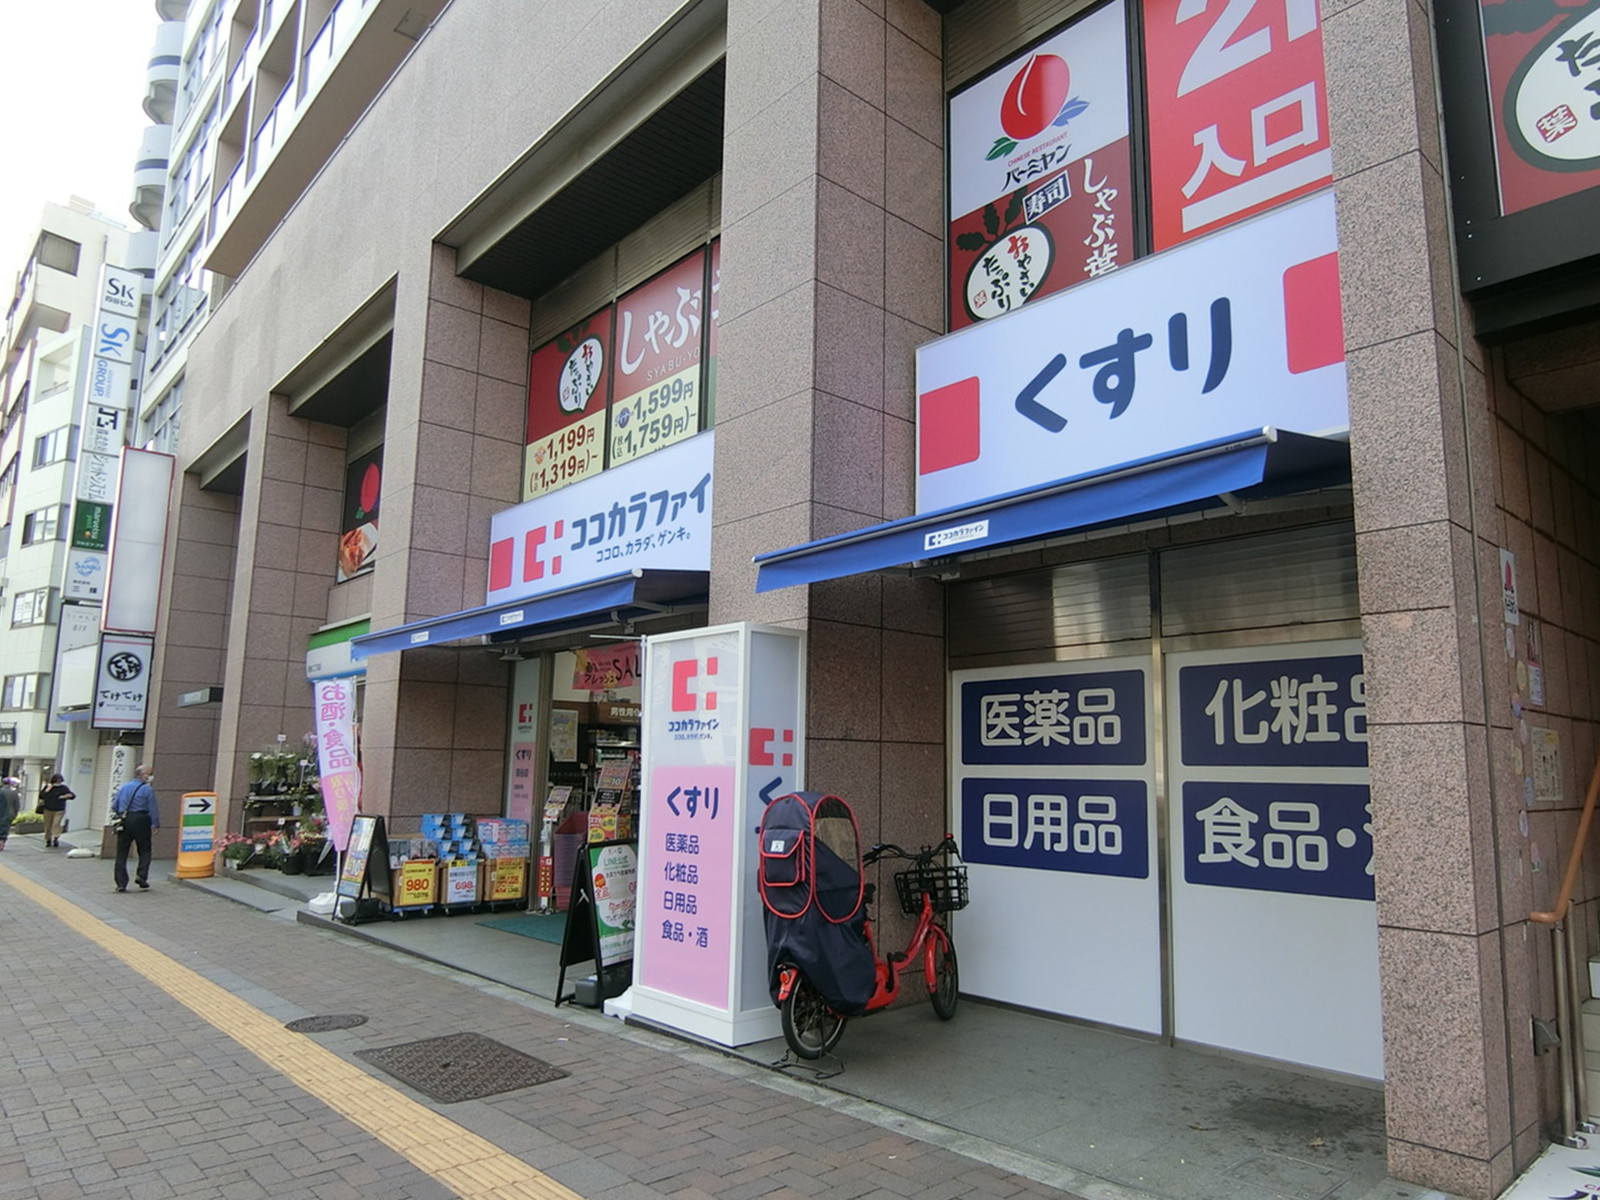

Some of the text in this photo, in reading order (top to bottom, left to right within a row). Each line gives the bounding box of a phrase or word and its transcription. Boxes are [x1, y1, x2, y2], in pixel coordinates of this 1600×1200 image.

[1174, 0, 1318, 99] 2
[1008, 131, 1069, 167] CHINESE RESTAURANT
[1181, 80, 1319, 200] 入口
[1001, 143, 1072, 192] バーミヤン
[1026, 176, 1067, 219] 寿司
[106, 277, 135, 300] SK
[99, 323, 131, 357] SK
[621, 283, 719, 376] しゃぶ
[1014, 296, 1232, 435] くすり
[634, 377, 694, 422] 1,599円
[547, 424, 595, 462] 1,199円
[571, 473, 711, 551] ココカラファイ
[596, 526, 691, 563] ココロ、カラダ、ゲンキ。
[100, 690, 143, 702] てけてけ
[320, 684, 352, 769] お酒・食品
[668, 718, 719, 732] ココカラファイン
[981, 688, 1121, 747] 医薬品
[667, 786, 719, 820] くすり
[982, 794, 1123, 855] 日用品
[1195, 797, 1376, 872] 食品・
[665, 832, 700, 855] 医薬品
[406, 878, 429, 892] 980
[455, 881, 474, 890] 698
[664, 861, 699, 885] 化粧品
[663, 890, 698, 915] 日用品
[661, 919, 709, 949] 食品・酒
